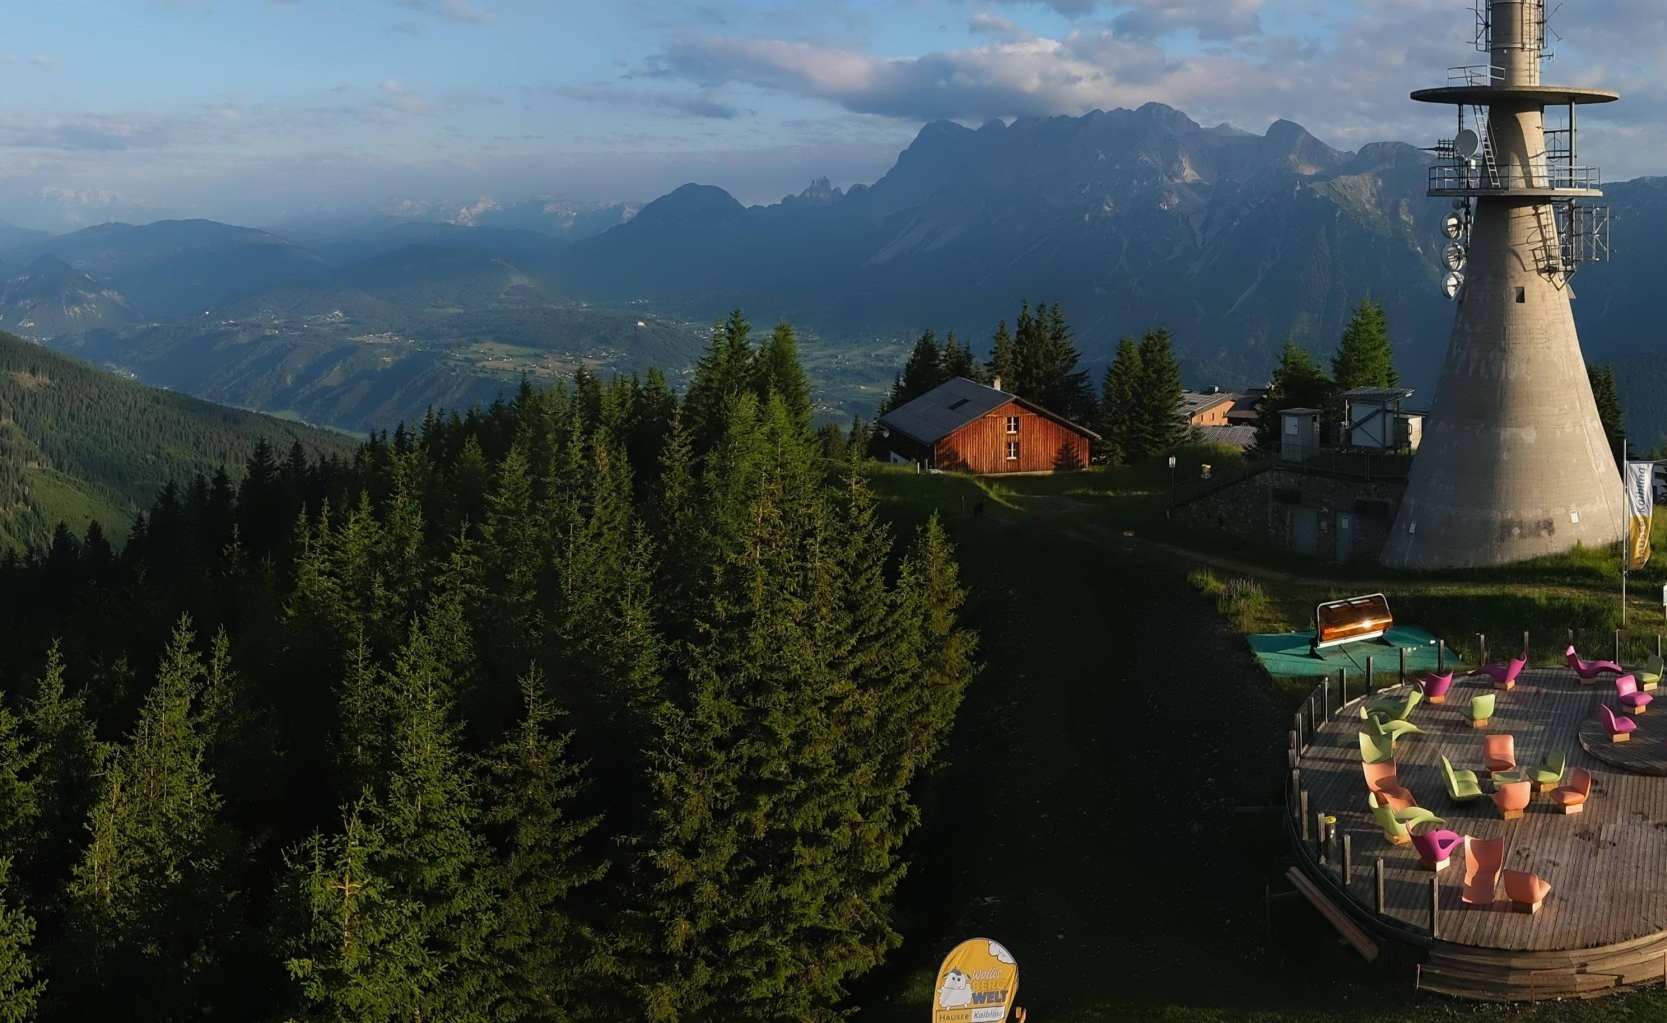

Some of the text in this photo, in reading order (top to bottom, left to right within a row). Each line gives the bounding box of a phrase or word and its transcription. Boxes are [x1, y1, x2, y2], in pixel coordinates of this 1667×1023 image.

[972, 980, 1006, 991] BERG
[972, 990, 1008, 1004] WELT
[940, 1014, 969, 1022] HAUSER
